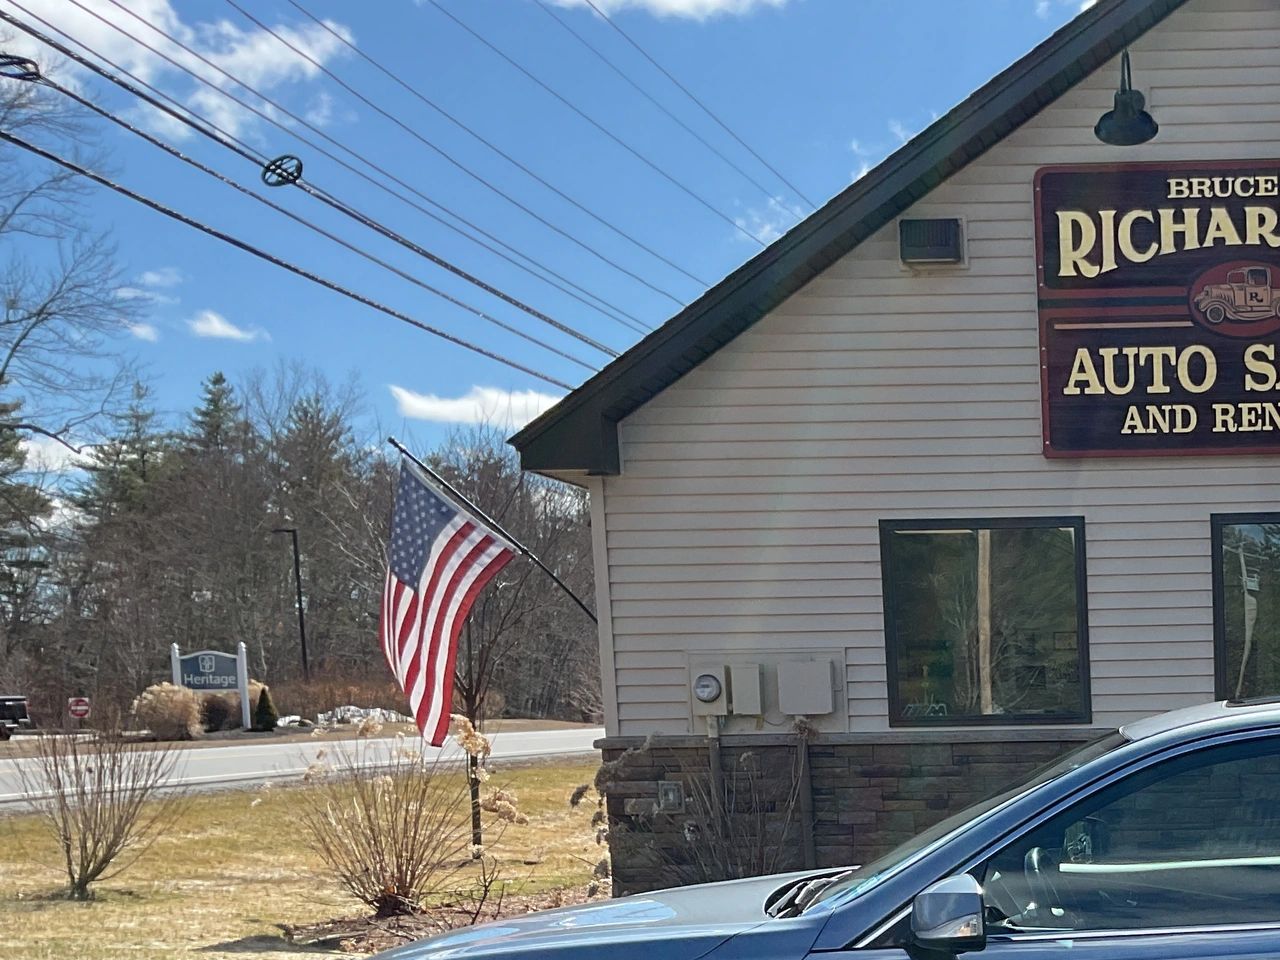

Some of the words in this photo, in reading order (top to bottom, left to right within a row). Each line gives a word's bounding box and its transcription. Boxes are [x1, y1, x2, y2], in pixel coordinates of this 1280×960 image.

[1167, 176, 1278, 199] BRUCE
[1250, 291, 1264, 303] R
[1063, 344, 1217, 395] AUTO
[1121, 405, 1197, 435] AND
[184, 673, 236, 687] Heritage
